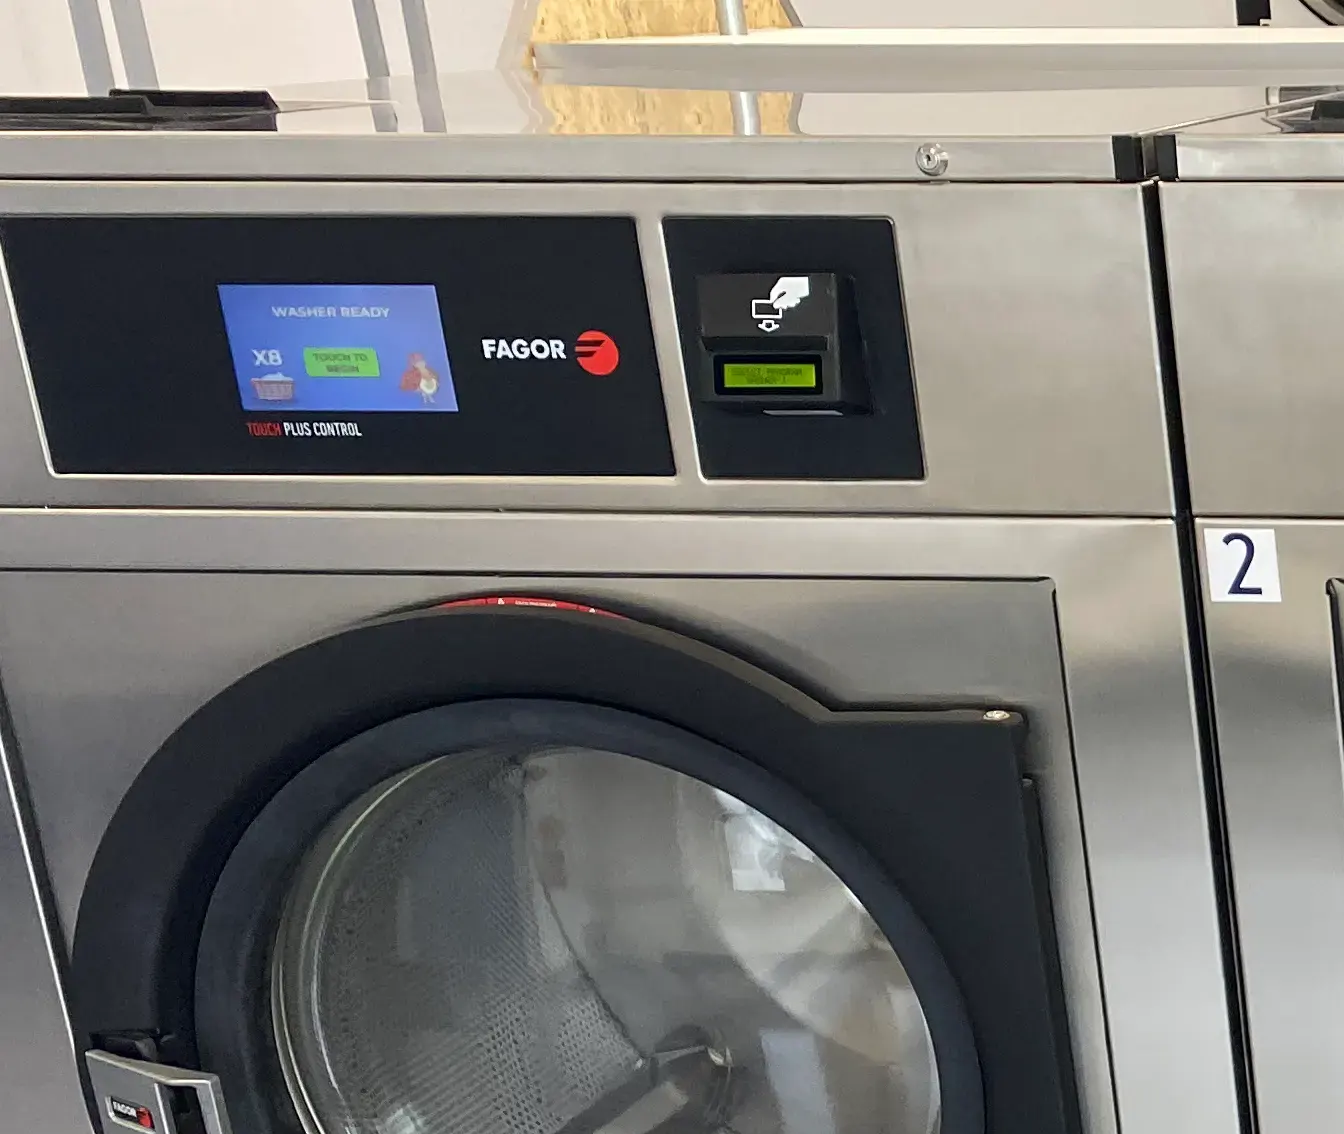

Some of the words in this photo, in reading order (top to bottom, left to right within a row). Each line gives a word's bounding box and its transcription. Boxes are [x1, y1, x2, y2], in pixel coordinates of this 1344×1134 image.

[271, 306, 337, 318] WASHER
[341, 306, 390, 318] READY
[252, 349, 283, 367] X8
[312, 352, 351, 362] TOUCH
[354, 353, 369, 362] TO
[481, 338, 567, 360] FAGOR
[246, 422, 282, 436] TOUCH
[283, 422, 312, 436] PLUS
[313, 422, 362, 437] CONTROL
[1222, 532, 1262, 595] 2
[112, 1100, 137, 1118] FAGOR
